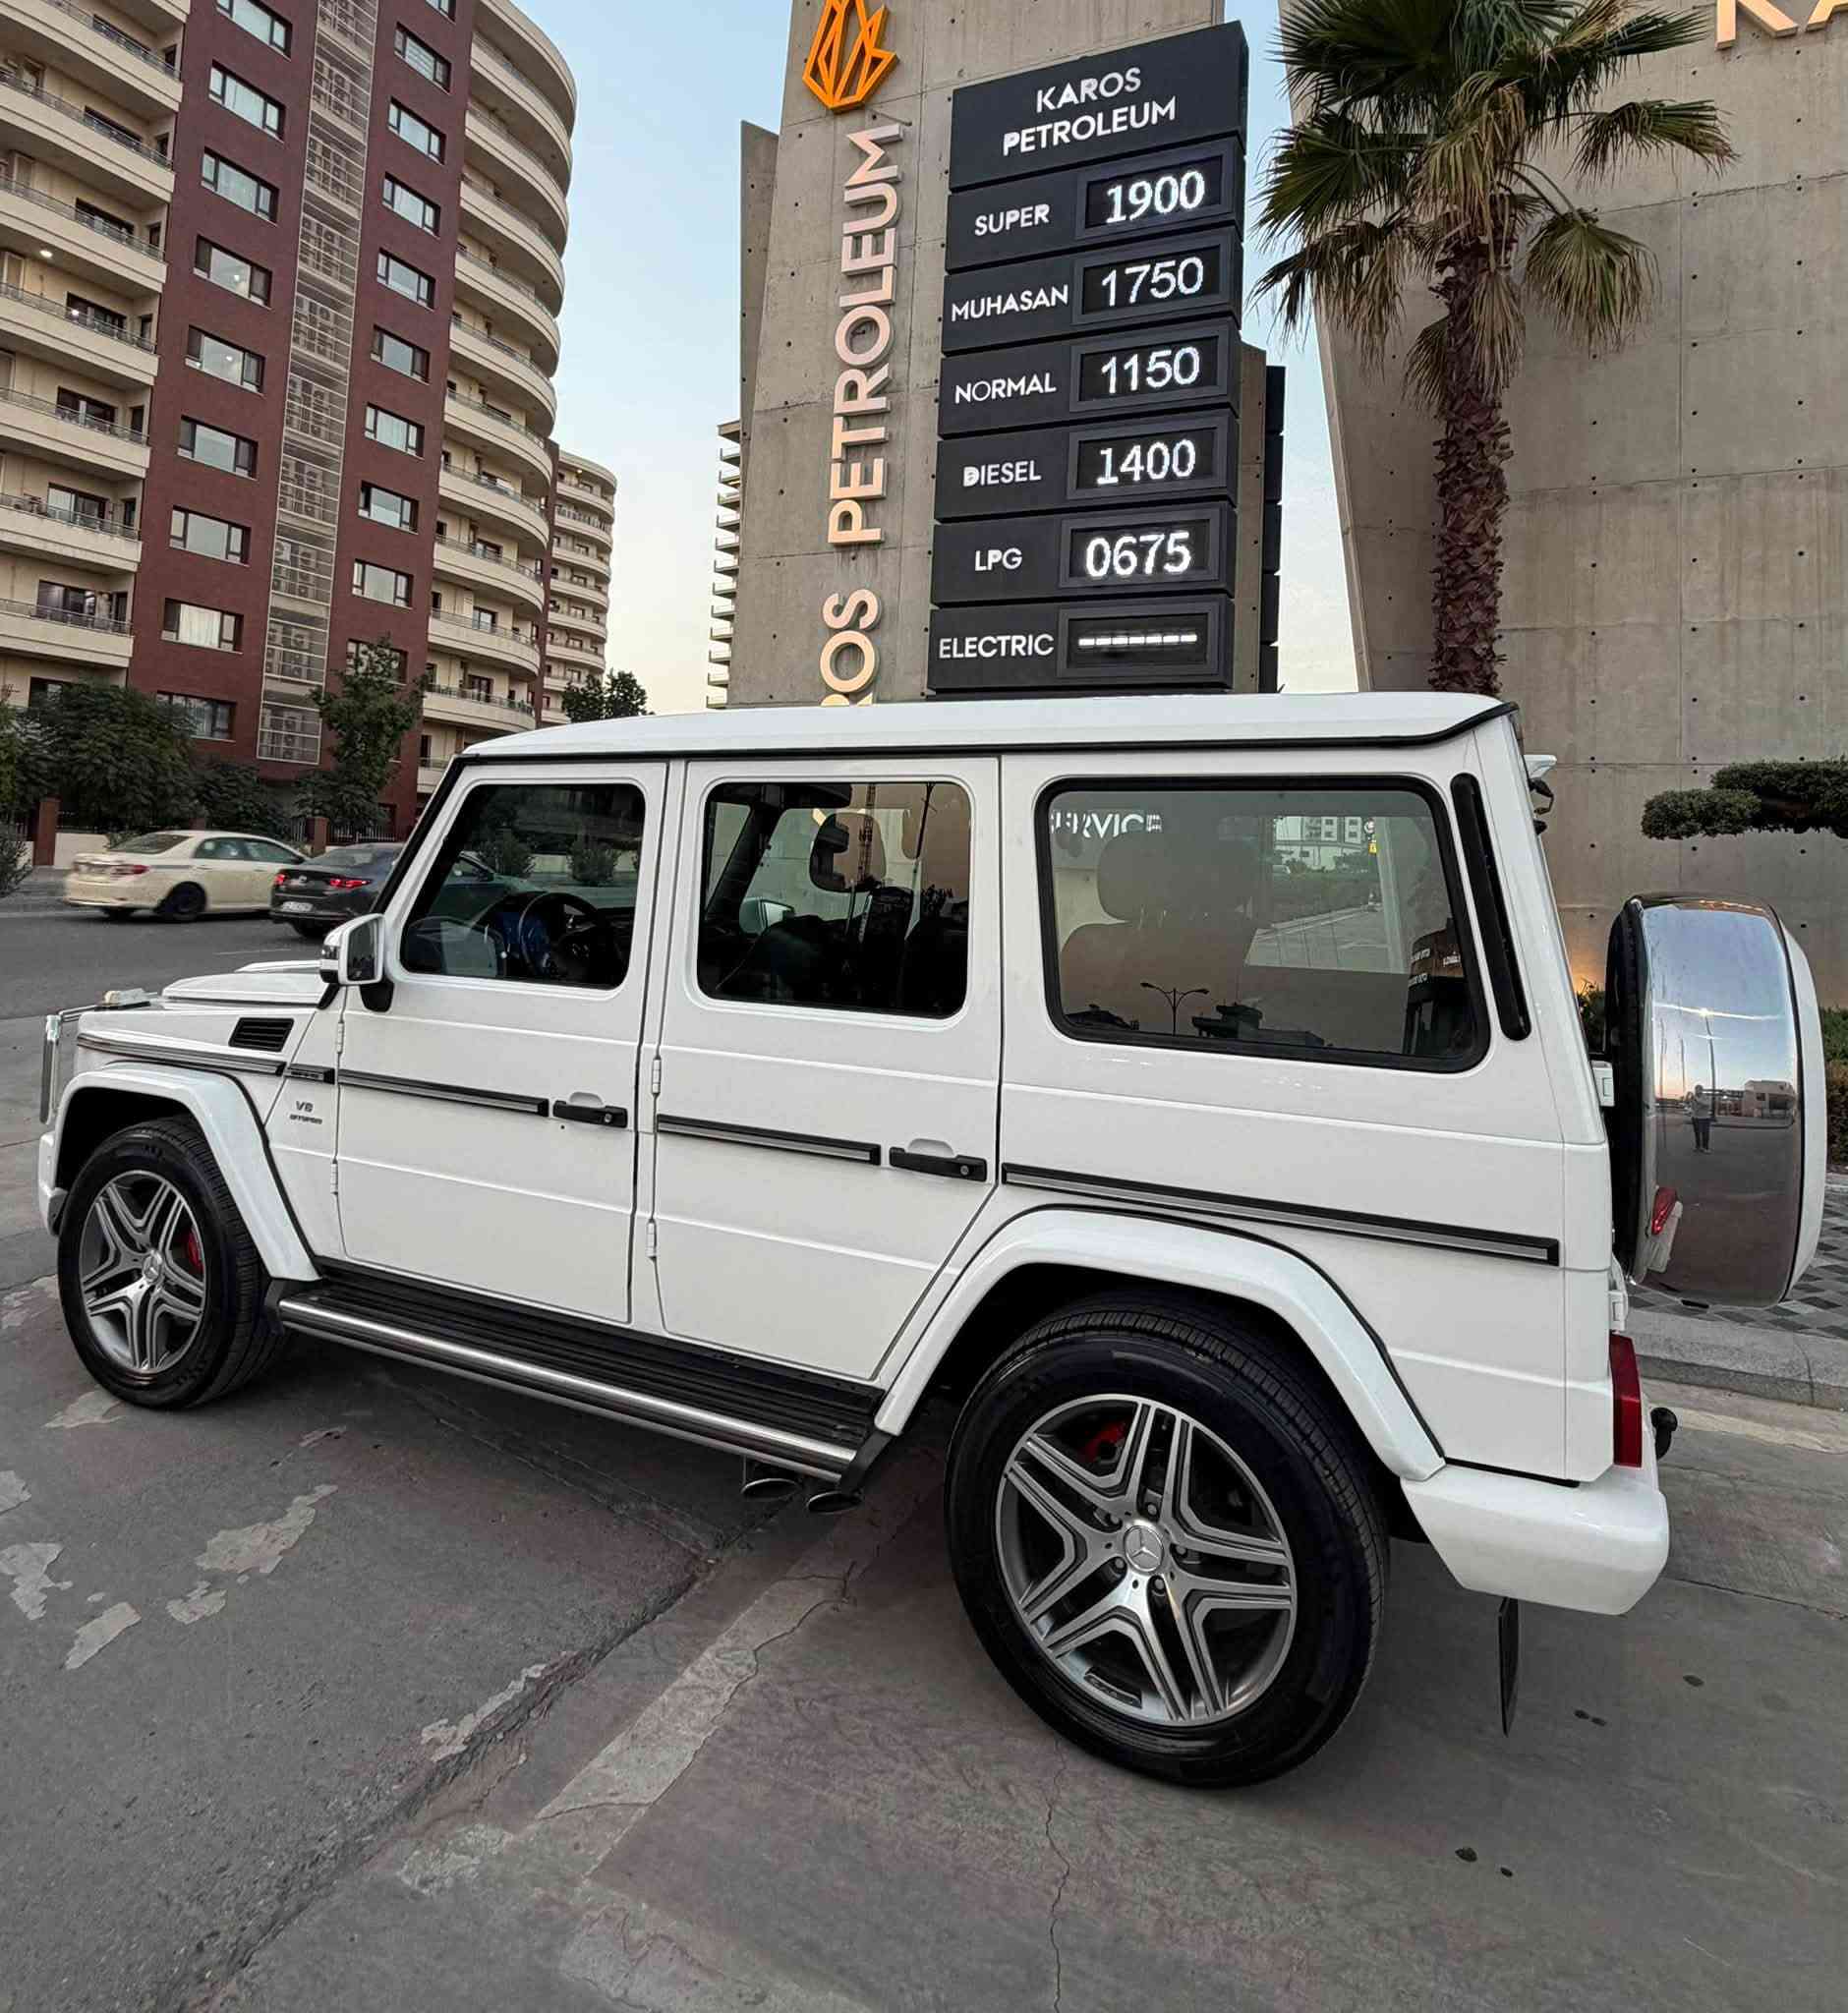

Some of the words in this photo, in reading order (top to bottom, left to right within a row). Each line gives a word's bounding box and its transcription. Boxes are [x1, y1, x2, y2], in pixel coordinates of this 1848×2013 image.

[1036, 67, 1141, 113] KAROS
[1003, 95, 1177, 156] PETROLEUM
[974, 203, 1051, 236] SUPER
[1106, 169, 1205, 223] 1900
[952, 284, 1068, 321] MUHASAN
[1101, 256, 1204, 307] 1750
[828, 124, 901, 546] PETROLEUM
[954, 373, 1057, 404] NORMAL
[1101, 346, 1200, 394] 1150
[962, 460, 1042, 487] DIESEL
[1097, 438, 1196, 485] 1400
[974, 547, 1022, 571] LPG
[1085, 531, 1191, 577] 0675
[939, 634, 1054, 659] ELECTRIC
